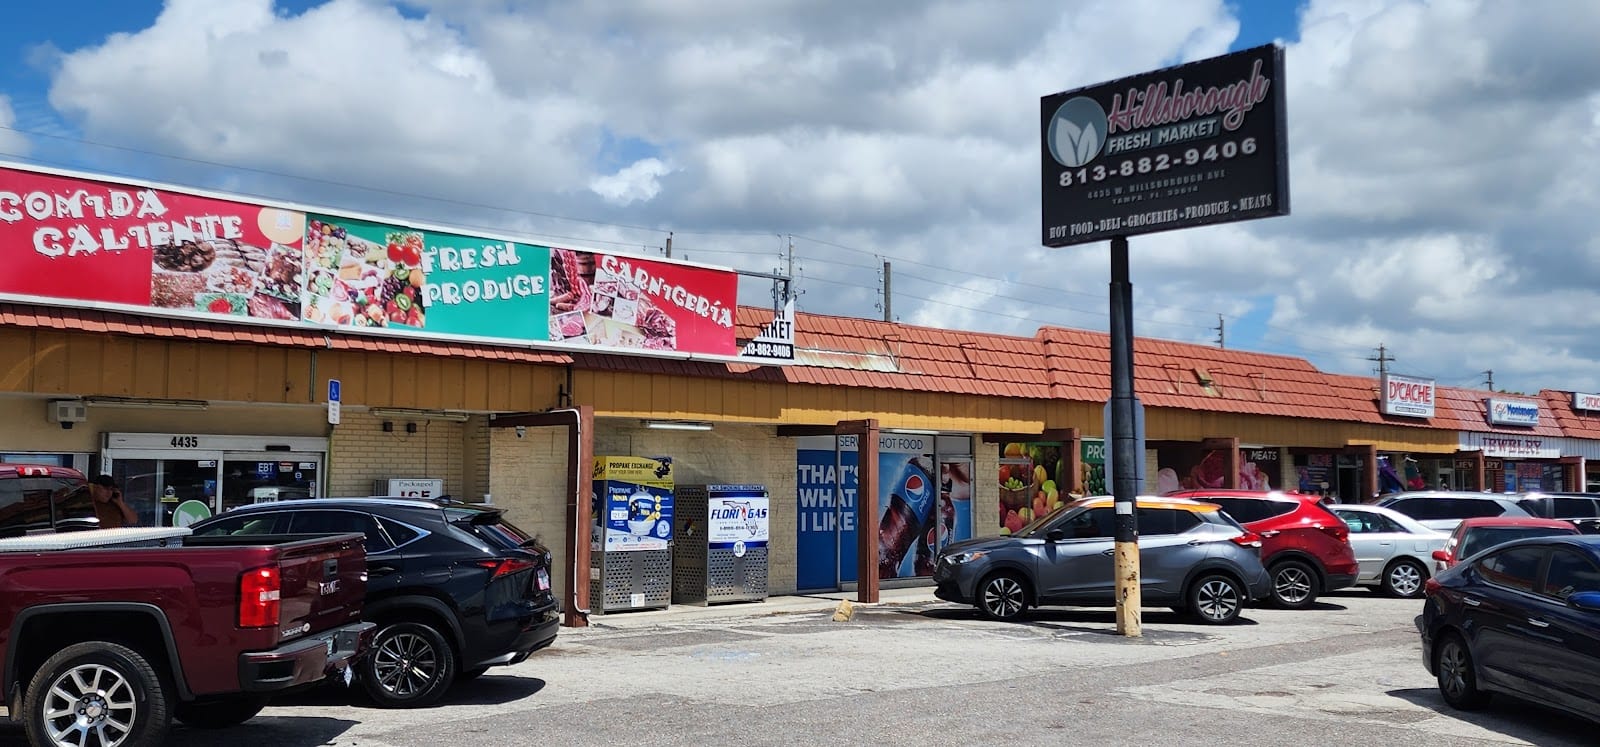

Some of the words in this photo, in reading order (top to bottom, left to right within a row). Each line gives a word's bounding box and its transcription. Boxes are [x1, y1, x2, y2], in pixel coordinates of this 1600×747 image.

[1107, 59, 1270, 133] Hillsborough
[1108, 131, 1152, 154] FRESH
[1158, 119, 1218, 144] MARKET
[1059, 137, 1257, 187] 813-882-9406
[1207, 169, 1226, 180] AVE
[0, 187, 169, 223] COMIDA
[1049, 226, 1068, 240] HOT
[1070, 223, 1094, 236] FOOD
[1099, 216, 1121, 233] DELI
[1127, 208, 1179, 228] GROCERIES
[1185, 200, 1230, 220] PRODUCE
[1239, 194, 1273, 212] MEATS
[33, 214, 243, 259] CALIENTE
[419, 242, 522, 275] FRESH
[420, 275, 546, 308] PRODUCE
[1389, 381, 1432, 404] D'CACHE
[170, 435, 199, 449] 4435
[879, 438, 897, 449] HOT
[899, 439, 924, 450] FOOD
[609, 462, 631, 470] PROPANE
[1251, 450, 1277, 461] MEATS
[258, 462, 274, 473] EBT
[401, 490, 431, 498] ICE
[799, 488, 857, 508] WHAT
[711, 508, 740, 520] FLORI
[748, 508, 768, 519] GAS
[801, 511, 807, 532] I
[812, 511, 855, 532] LIKE
